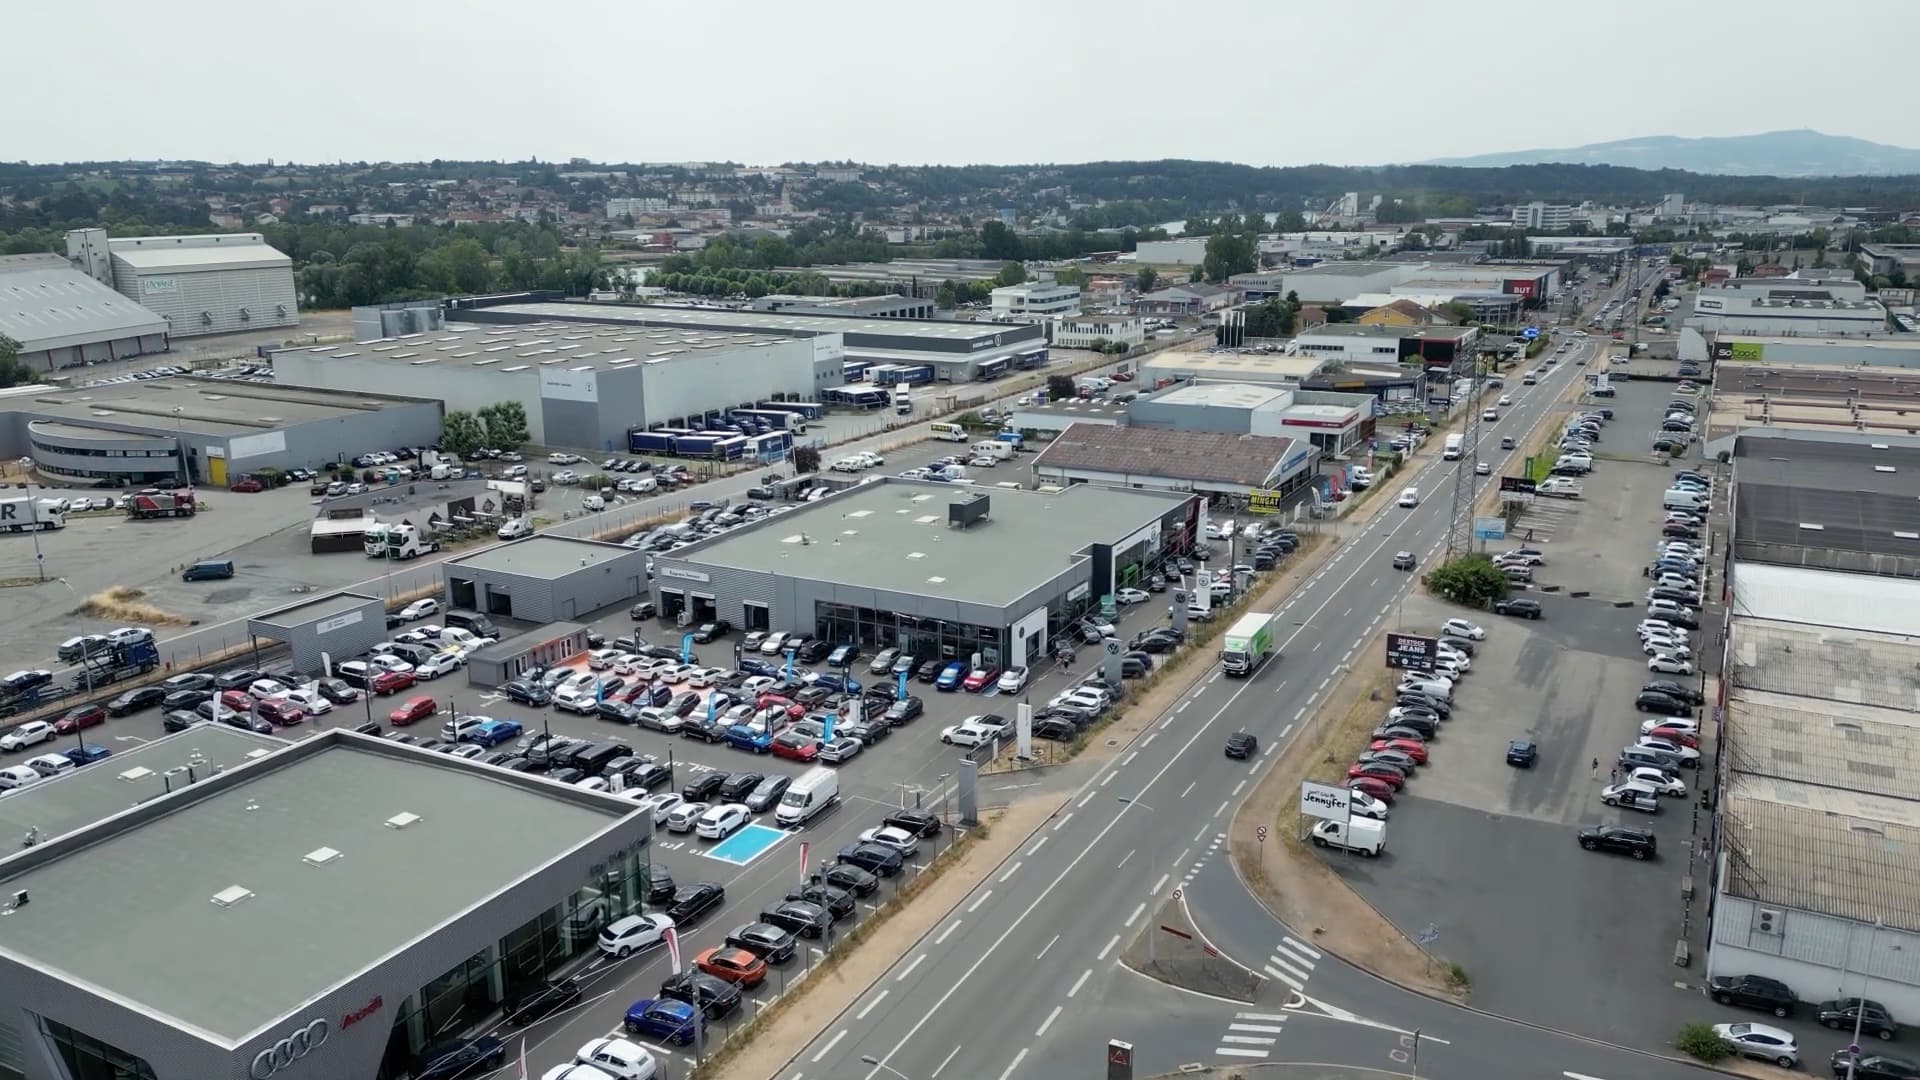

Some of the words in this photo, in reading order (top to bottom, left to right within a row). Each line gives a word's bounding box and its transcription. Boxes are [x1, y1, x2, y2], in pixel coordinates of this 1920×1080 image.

[1513, 286, 1531, 294] BUT
[1250, 495, 1279, 505] MINGAT
[1398, 645, 1426, 654] JEANS
[1303, 792, 1347, 808] Jennyfer
